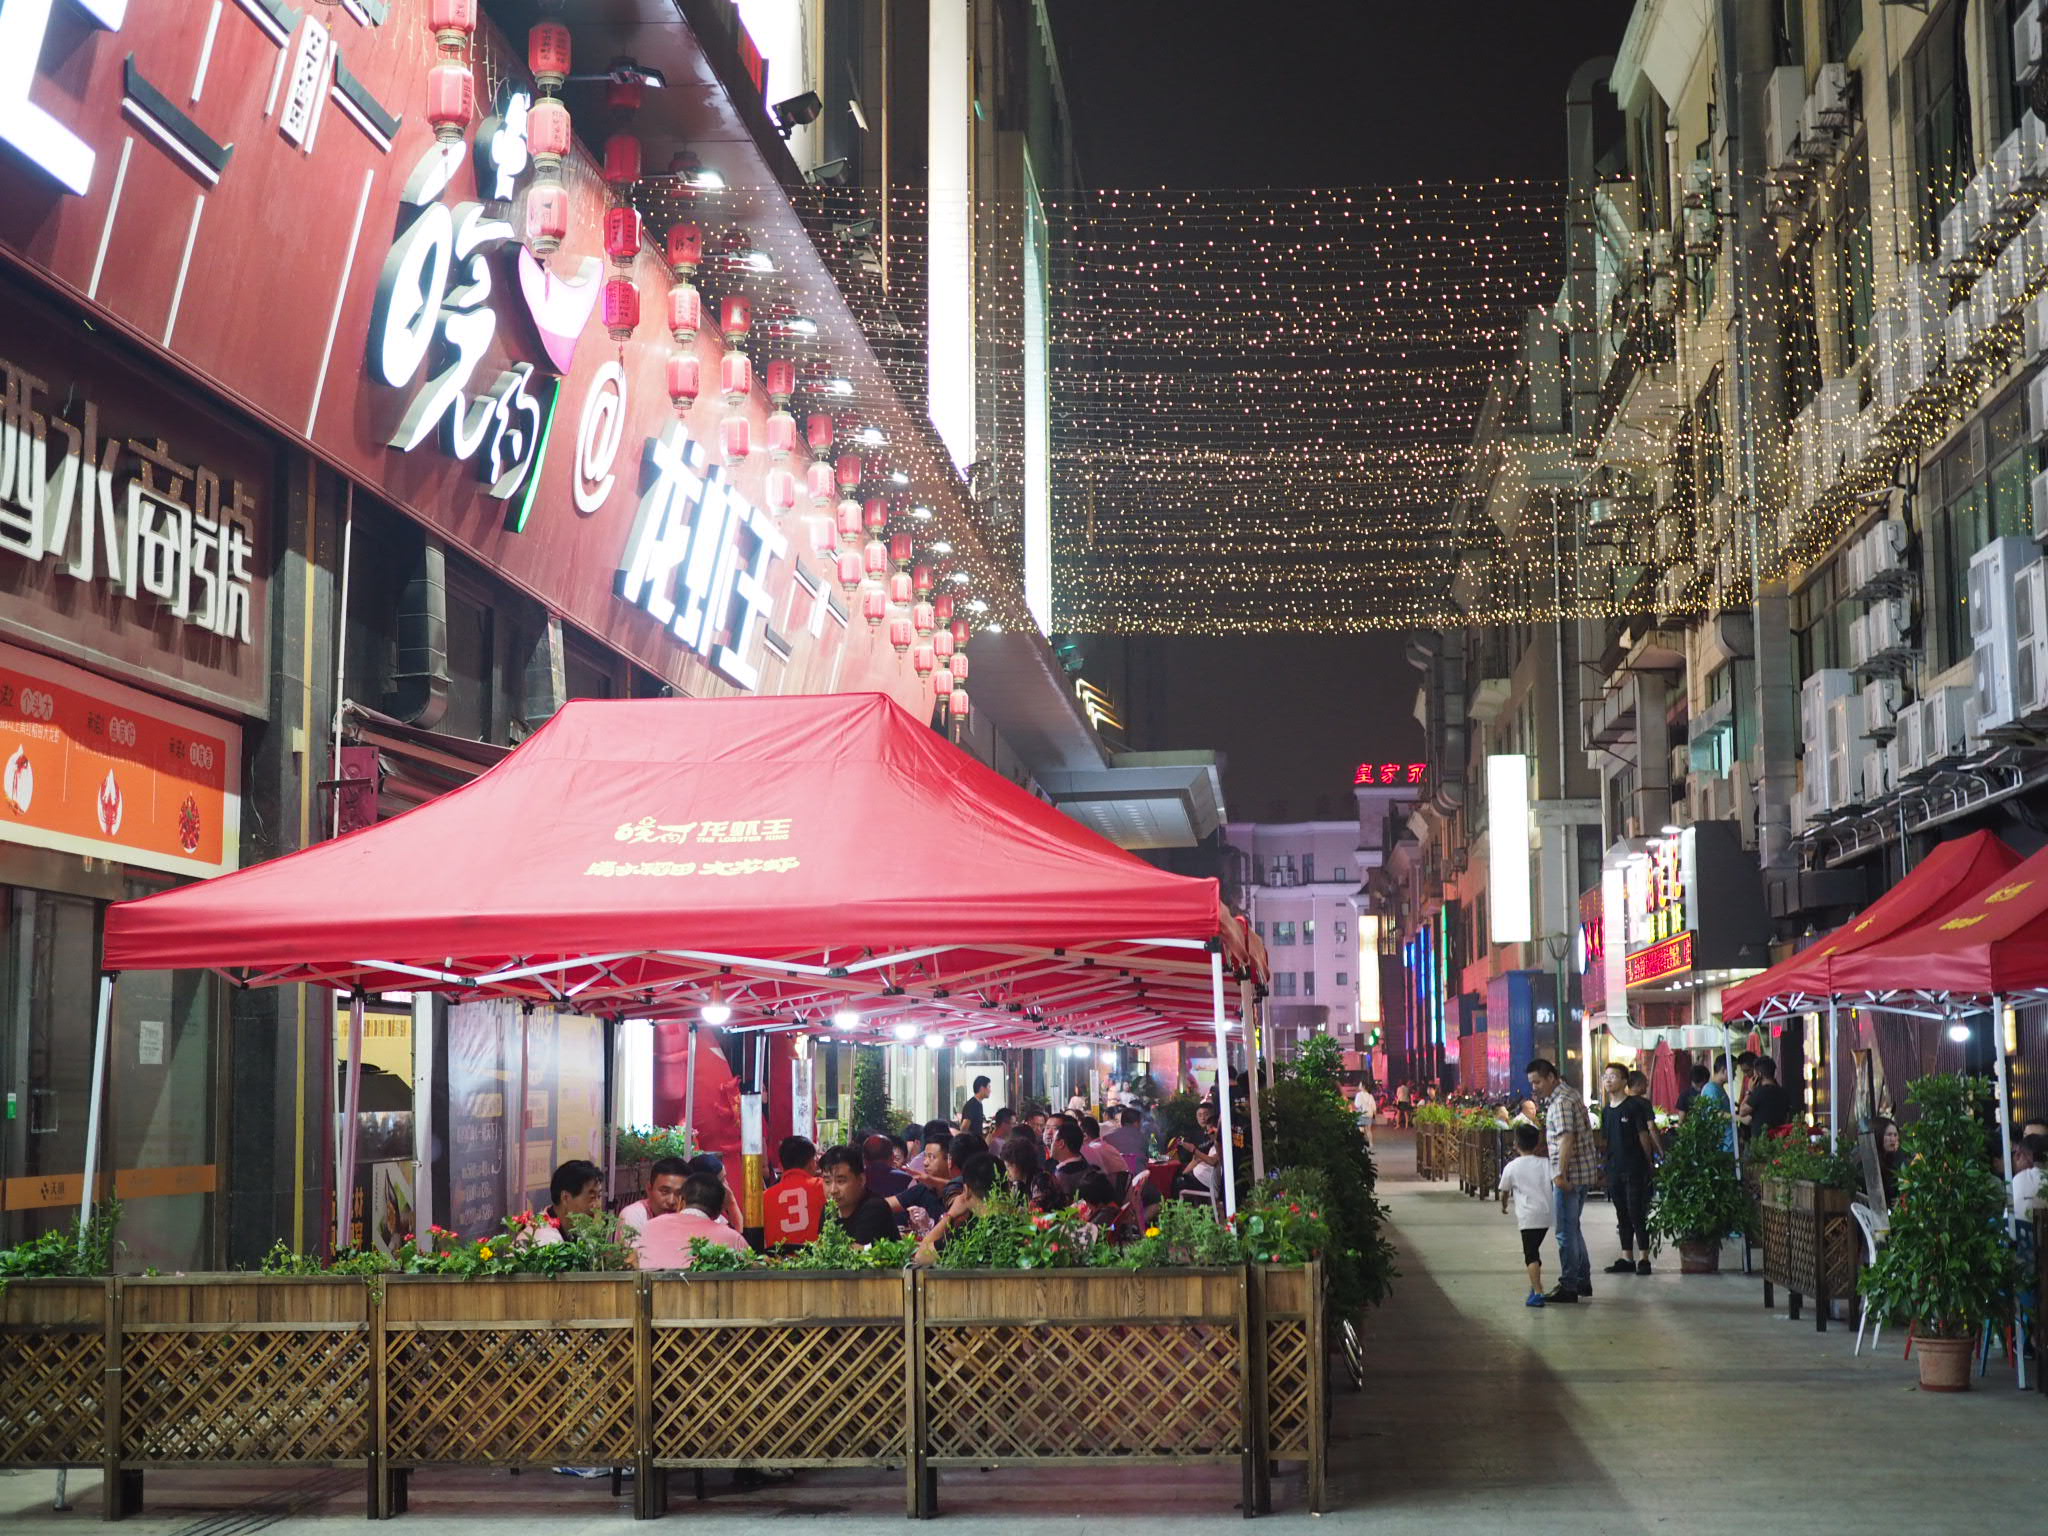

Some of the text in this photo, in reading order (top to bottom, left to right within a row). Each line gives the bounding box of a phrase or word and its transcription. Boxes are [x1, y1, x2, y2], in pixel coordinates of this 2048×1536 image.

[574, 360, 627, 514] @
[624, 421, 788, 691] 龙虾王
[21, 688, 53, 719] 个头大
[698, 819, 793, 836] 龙虾王
[698, 856, 801, 876] 大龙虾
[778, 1187, 810, 1233] 3
